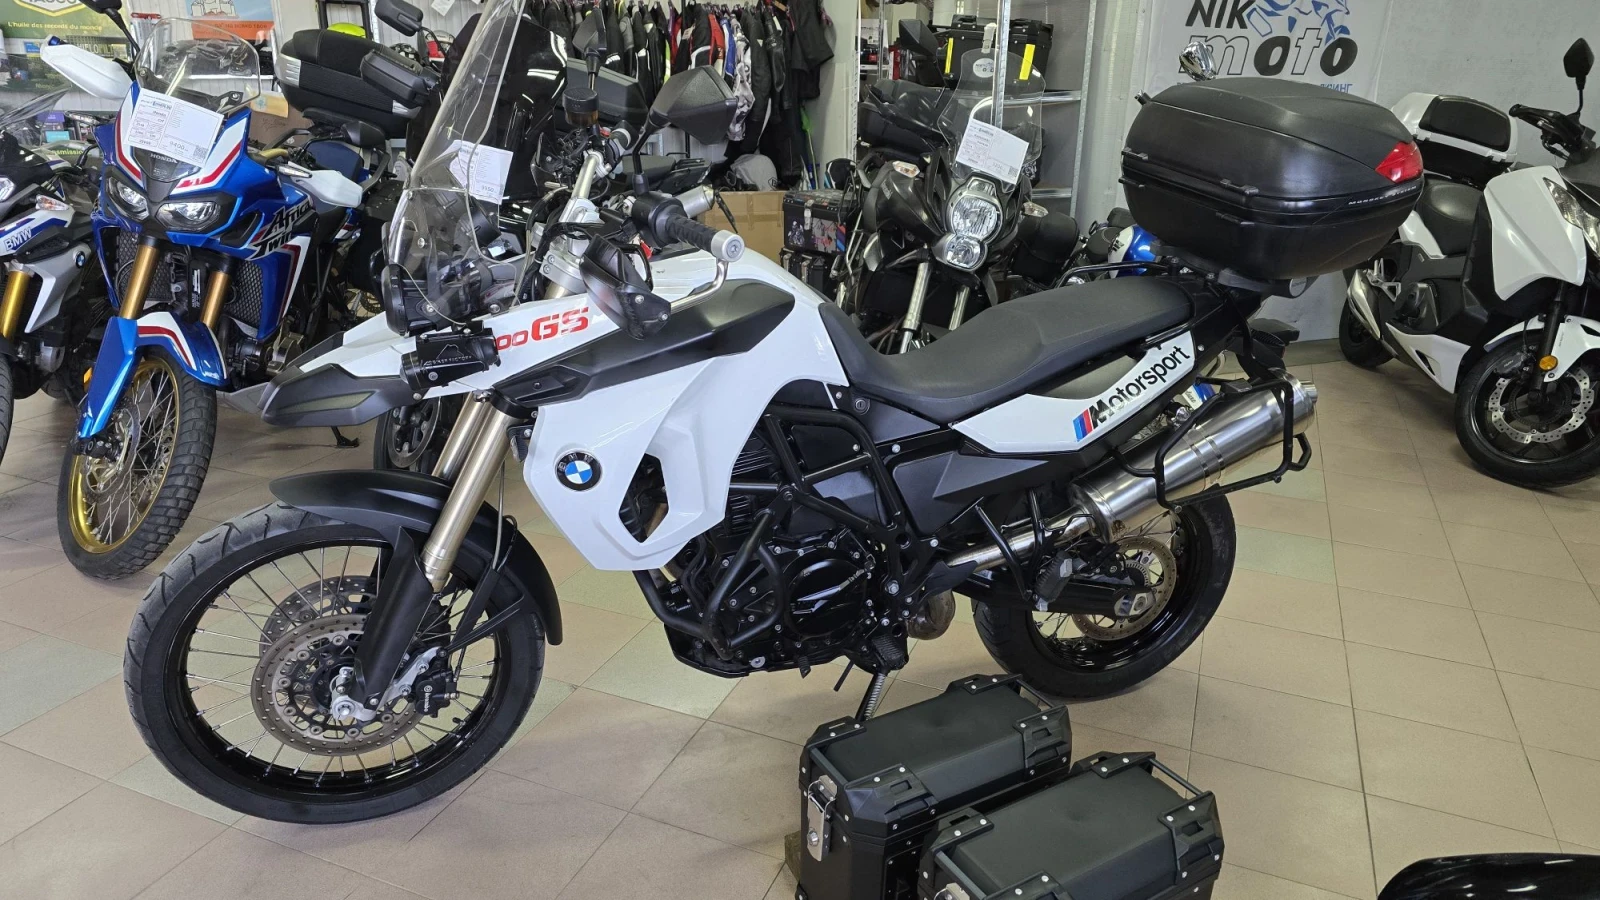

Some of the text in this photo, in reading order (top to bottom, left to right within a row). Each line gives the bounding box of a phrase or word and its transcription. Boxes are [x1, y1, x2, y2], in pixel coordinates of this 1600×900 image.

[1185, 0, 1256, 29] NIK
[1178, 28, 1358, 77] moto
[150, 152, 178, 164] HONDA
[4, 227, 33, 252] BMW
[557, 452, 593, 473] BMW
